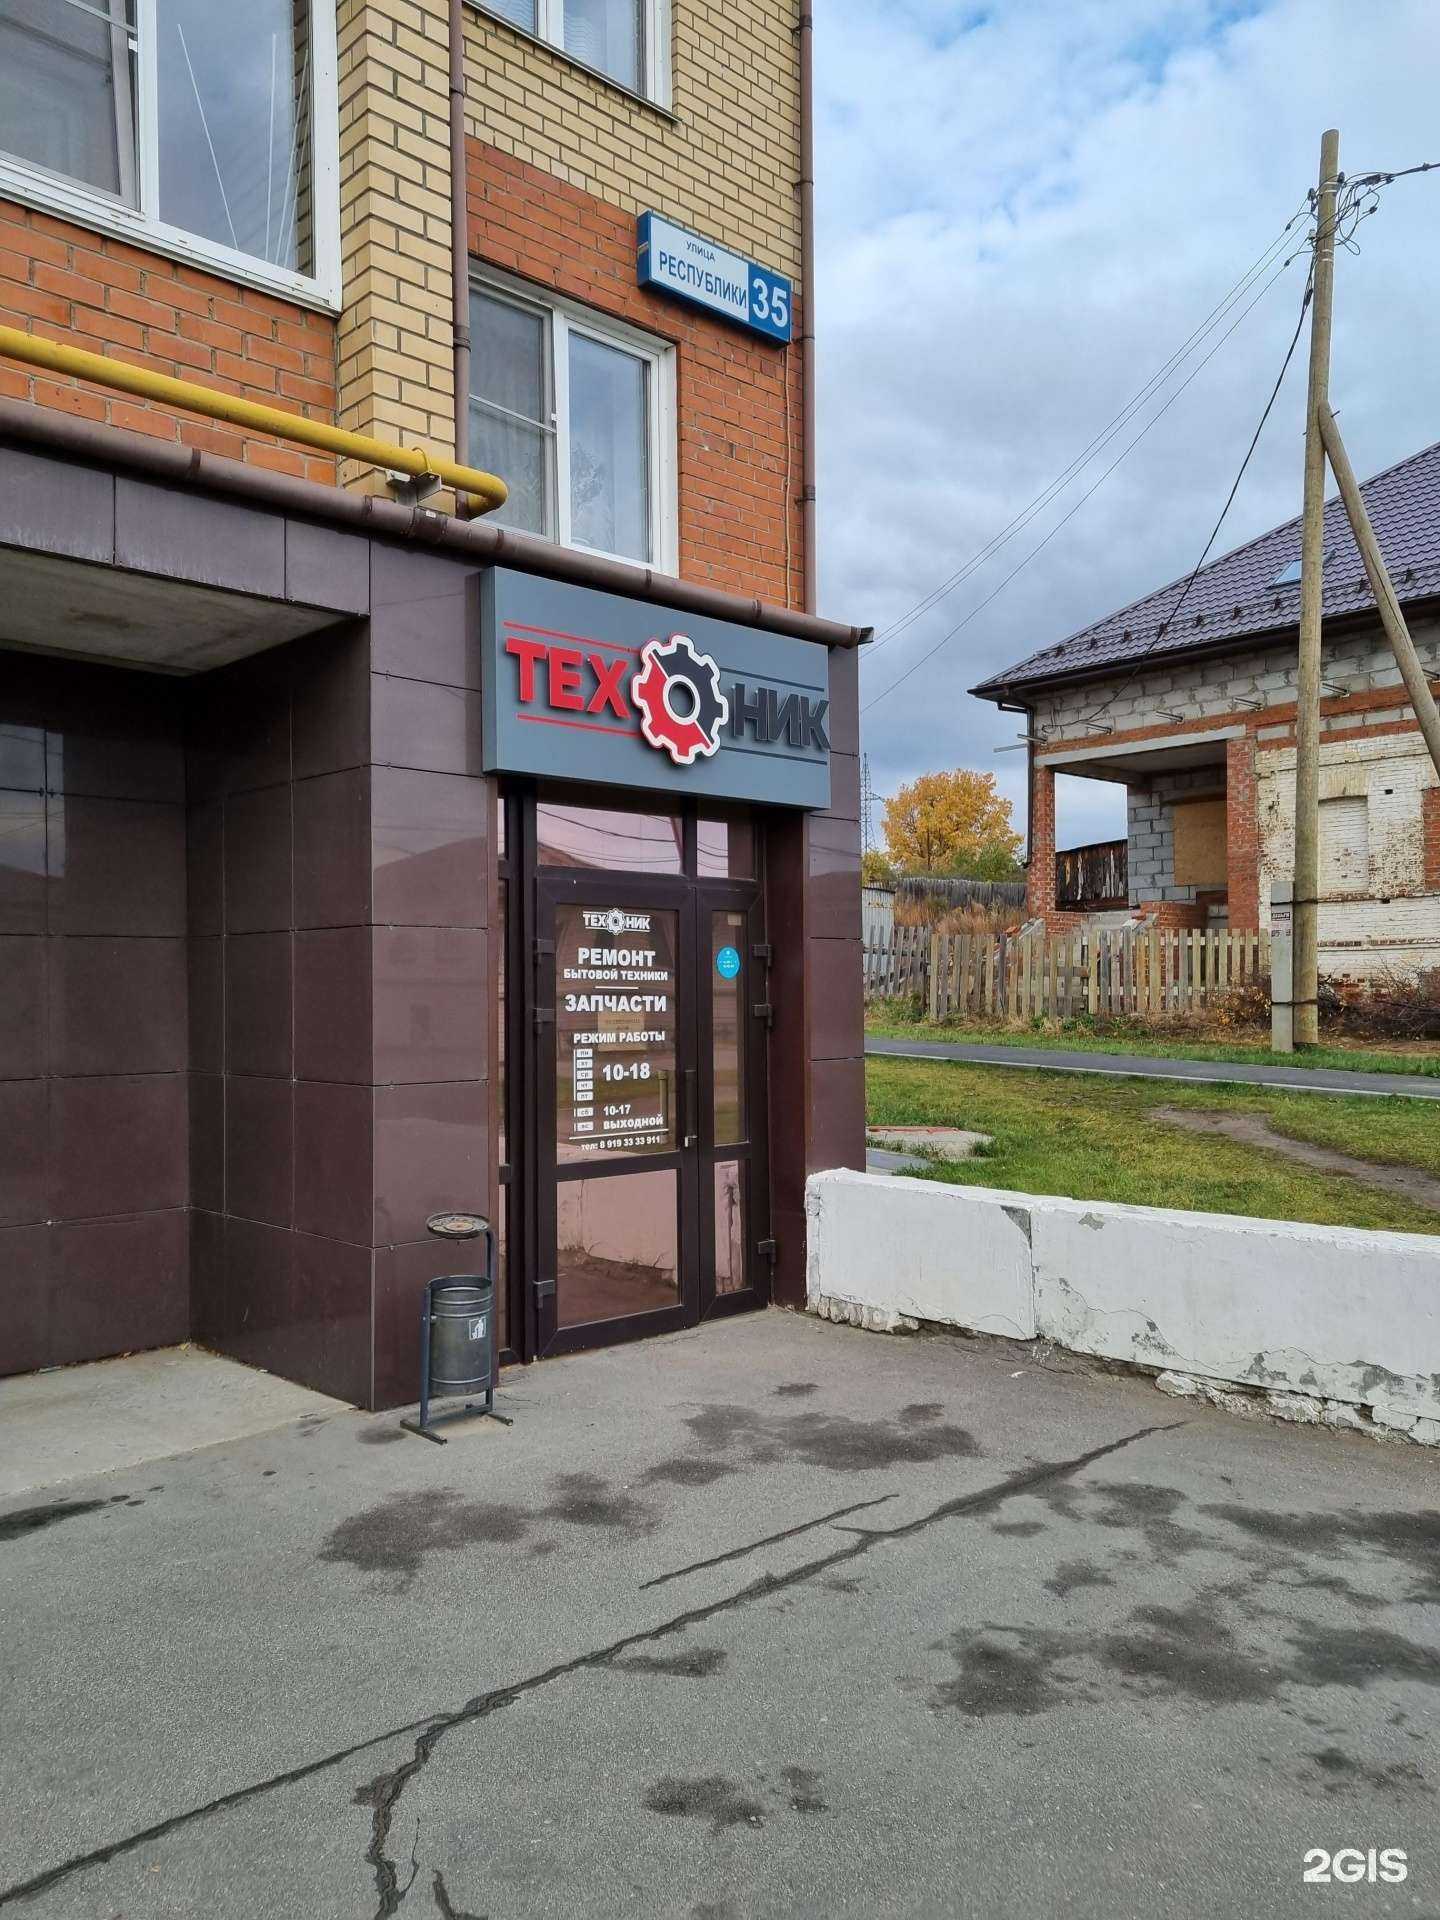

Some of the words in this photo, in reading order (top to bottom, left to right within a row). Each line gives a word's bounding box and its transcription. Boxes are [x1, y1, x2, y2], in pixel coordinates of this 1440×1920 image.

[686, 240, 716, 262] УЛИЦА
[659, 250, 747, 309] РЕСПУБЛИКИ
[752, 278, 788, 328] 35
[578, 947, 656, 967] РЕМОНТ
[564, 968, 618, 981] БЫТОВОЙ
[620, 970, 668, 981] ТЕХНИКИ
[565, 994, 667, 1012] ЗАПЧАСТИ
[573, 1032, 617, 1044] РЕЖИМ
[619, 1031, 665, 1043] РАБОТЫ
[602, 1062, 650, 1081] 10-18
[603, 1104, 631, 1116] 10-17
[600, 1140, 605, 1149] 8
[607, 1139, 622, 1148] 919
[623, 1138, 634, 1146] 33
[635, 1137, 645, 1145] 33
[646, 1135, 660, 1144] 911
